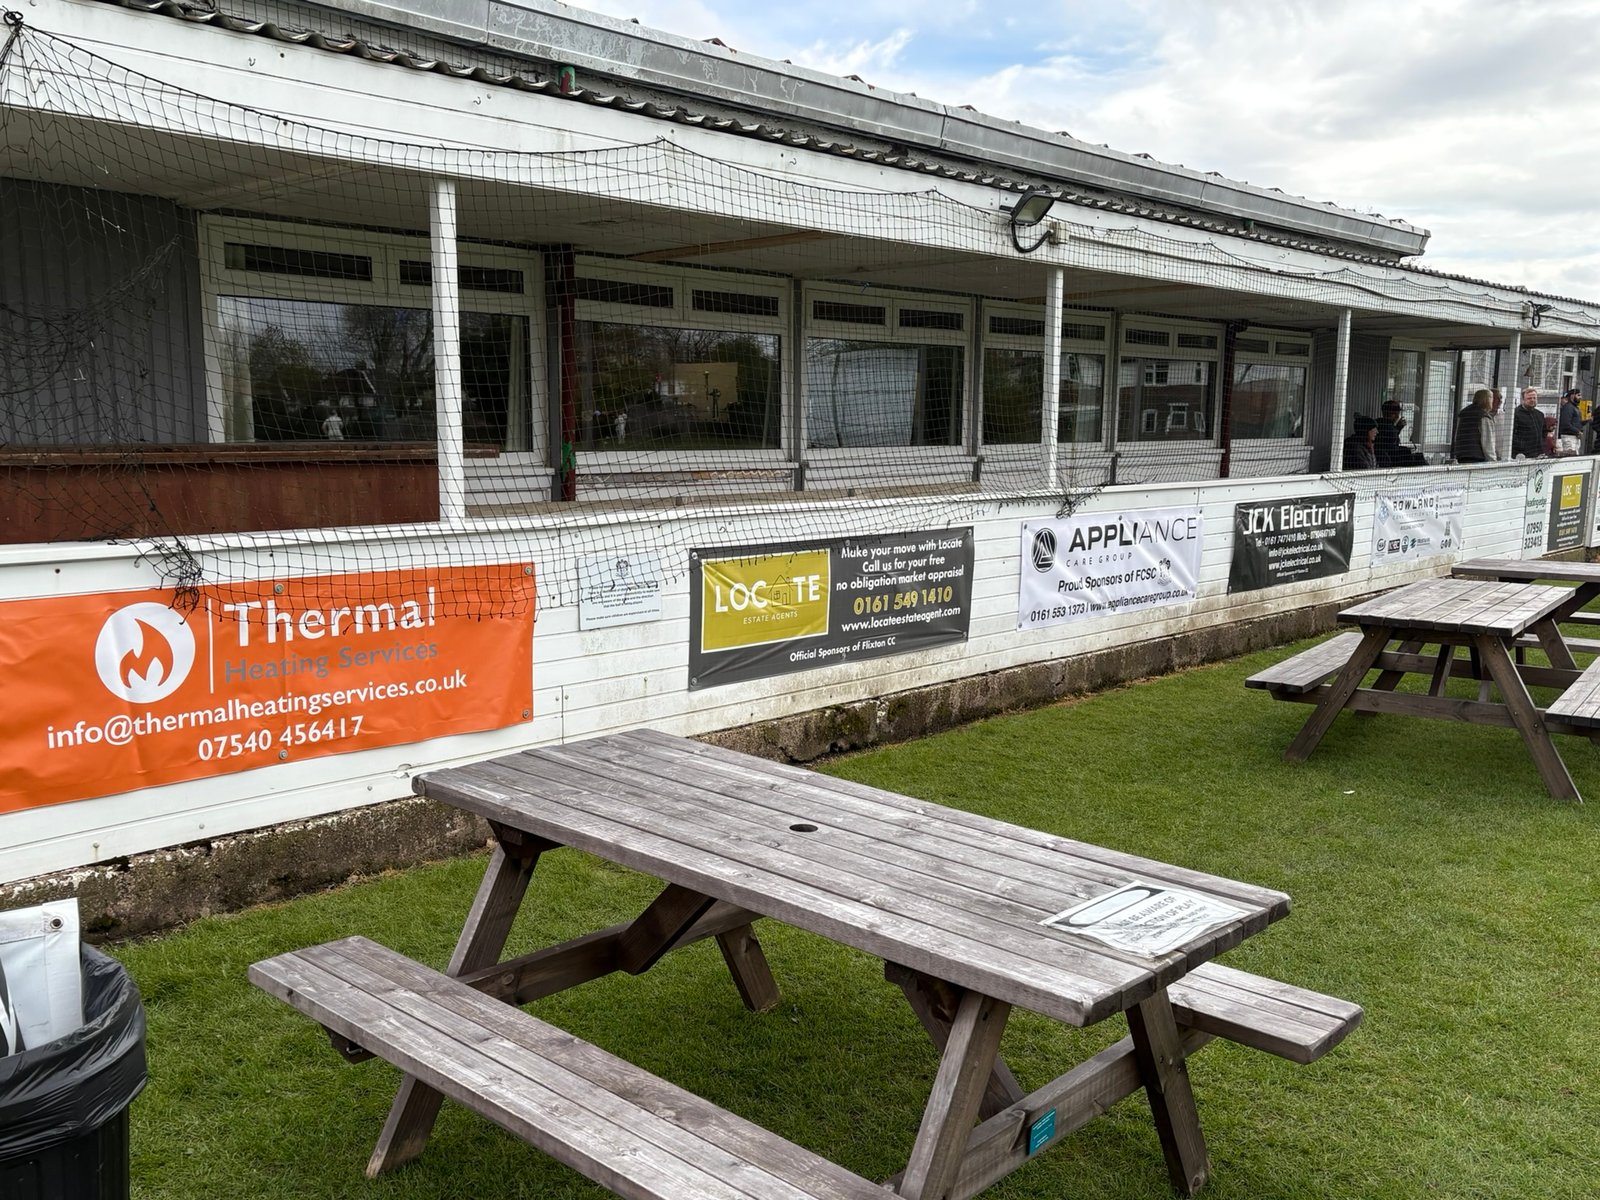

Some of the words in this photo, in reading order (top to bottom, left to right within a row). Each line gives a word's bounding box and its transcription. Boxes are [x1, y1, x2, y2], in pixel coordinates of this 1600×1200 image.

[1243, 506, 1275, 535] JCK
[1280, 499, 1349, 530] Electrical
[1392, 497, 1434, 511] ROWLAND
[1068, 517, 1197, 553] APPLIANCE
[841, 546, 868, 559] Make
[870, 547, 890, 559] your
[893, 544, 916, 554] move
[918, 539, 937, 551] with
[938, 539, 963, 550] Locate
[1066, 555, 1093, 568] CARE
[1099, 551, 1134, 564] GROUP
[862, 560, 880, 572] Call
[882, 562, 892, 571] us
[894, 558, 907, 570] for
[908, 558, 928, 570] your
[929, 554, 946, 565] free
[836, 581, 848, 591] no
[850, 576, 897, 590] obligation
[898, 571, 927, 583] market
[928, 565, 964, 582] appraisal
[1057, 577, 1084, 593] Proud
[1084, 573, 1122, 591] Sponsors
[1124, 569, 1135, 582] of
[1135, 567, 1157, 581] FCSC
[853, 594, 889, 615] 0161
[893, 590, 918, 610] 549
[922, 585, 953, 606] 1410
[1030, 609, 1050, 622] 0161
[1051, 605, 1066, 618] 553
[1068, 602, 1085, 616] 1373
[224, 586, 437, 647] Thermal
[743, 615, 769, 624] ESTATE
[771, 610, 798, 621] AGENTS
[841, 606, 961, 632] www.locateestateagent.com
[224, 648, 331, 684] Heating
[338, 639, 438, 670] Services
[789, 648, 817, 662] Official
[818, 645, 850, 659] Sponsors
[852, 641, 861, 651] of
[862, 638, 886, 650] Flixton
[887, 636, 896, 646] CC
[47, 669, 468, 749] info@thermalheatingservices.co.uk
[198, 729, 273, 761] 07540
[279, 715, 364, 753] 456417
